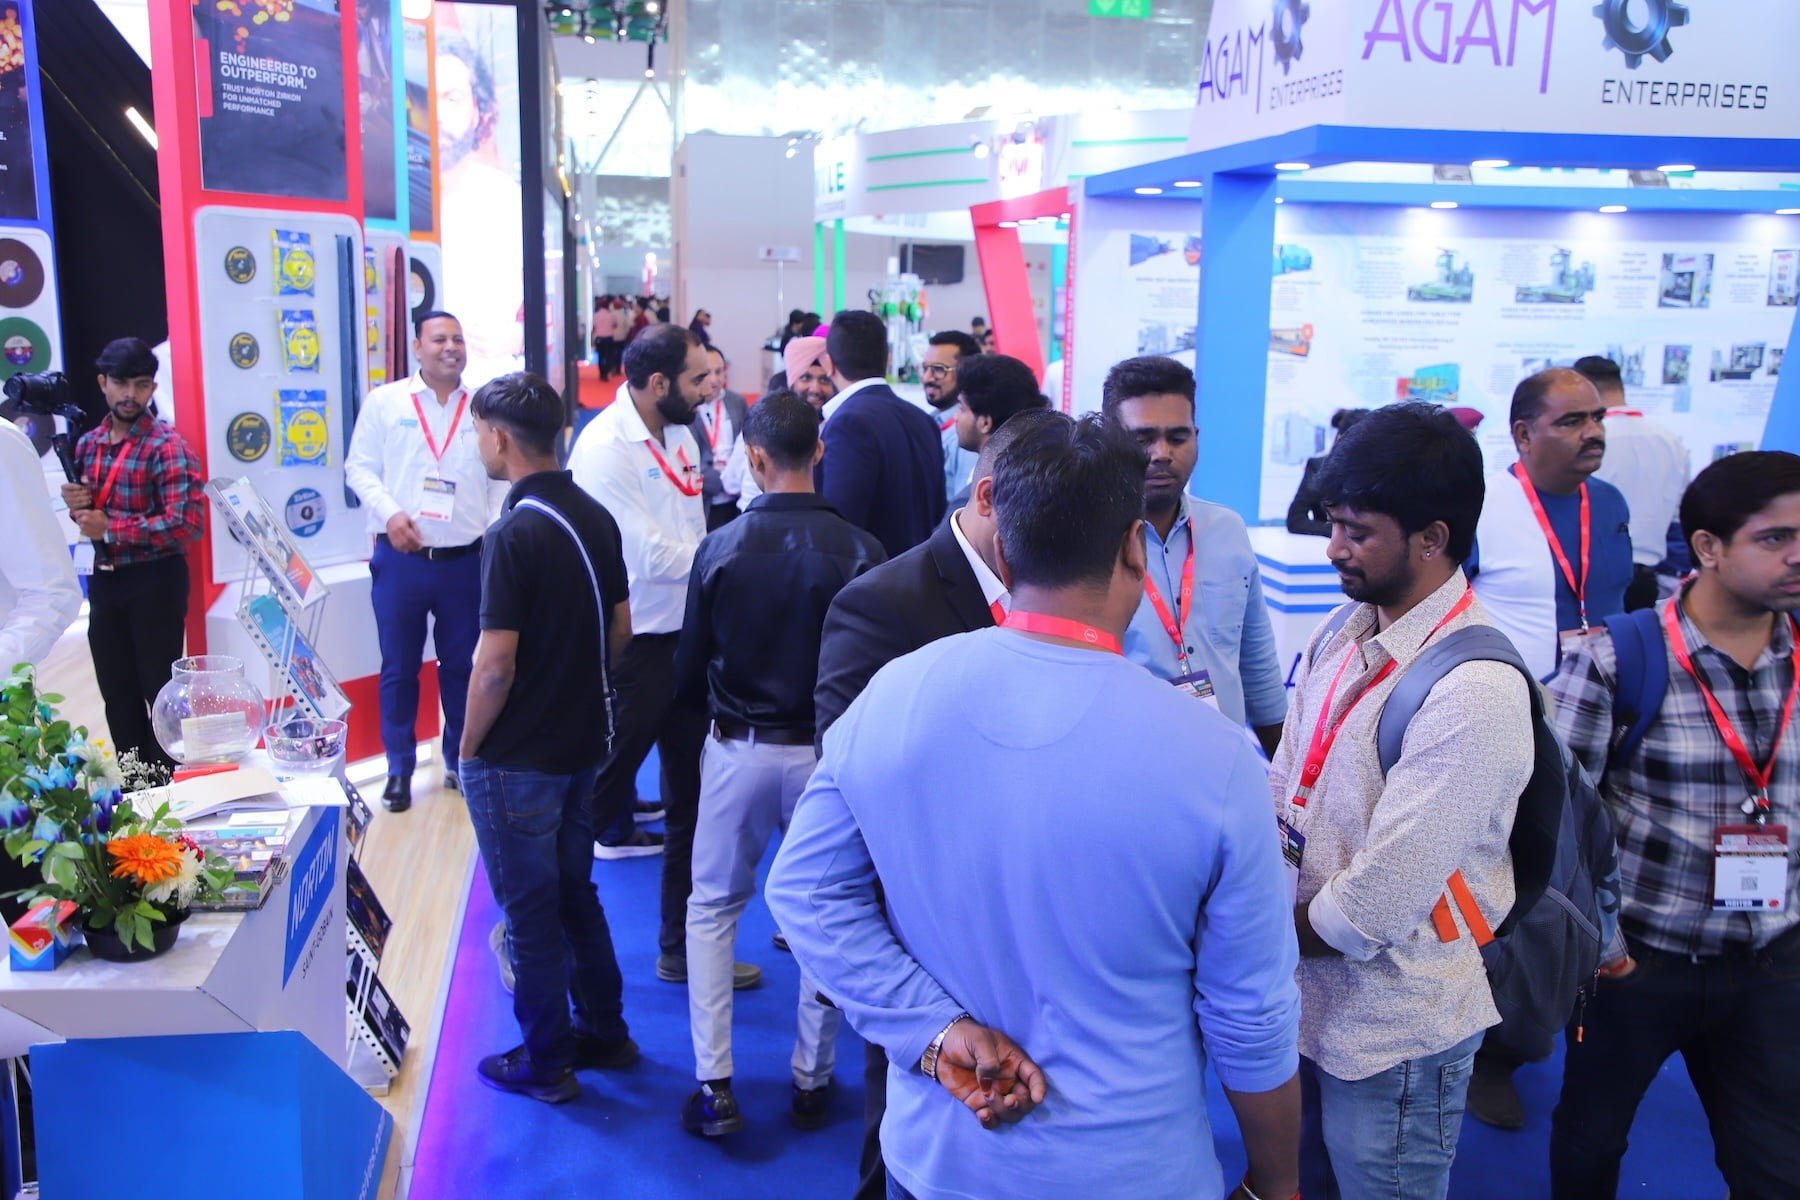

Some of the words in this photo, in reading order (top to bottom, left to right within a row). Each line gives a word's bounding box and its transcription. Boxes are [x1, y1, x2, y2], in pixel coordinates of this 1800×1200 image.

[1361, 0, 1557, 94] AGAM
[220, 51, 298, 76] ENGINEERED
[300, 65, 317, 79] TO
[220, 64, 307, 90] OUTPERFORM.
[1197, 19, 1265, 114] AGAM
[222, 83, 245, 93] TRUST
[246, 86, 275, 98] NORTON
[222, 92, 238, 102] FOR
[239, 95, 282, 108] UNMATCHED
[1270, 69, 1343, 110] ENTERPRISES
[1601, 79, 1768, 110] ENTERPRISES
[223, 102, 275, 116] PERFORMANCE
[290, 823, 335, 940] NORTON
[302, 904, 334, 980] SAINT-GOBAIN
